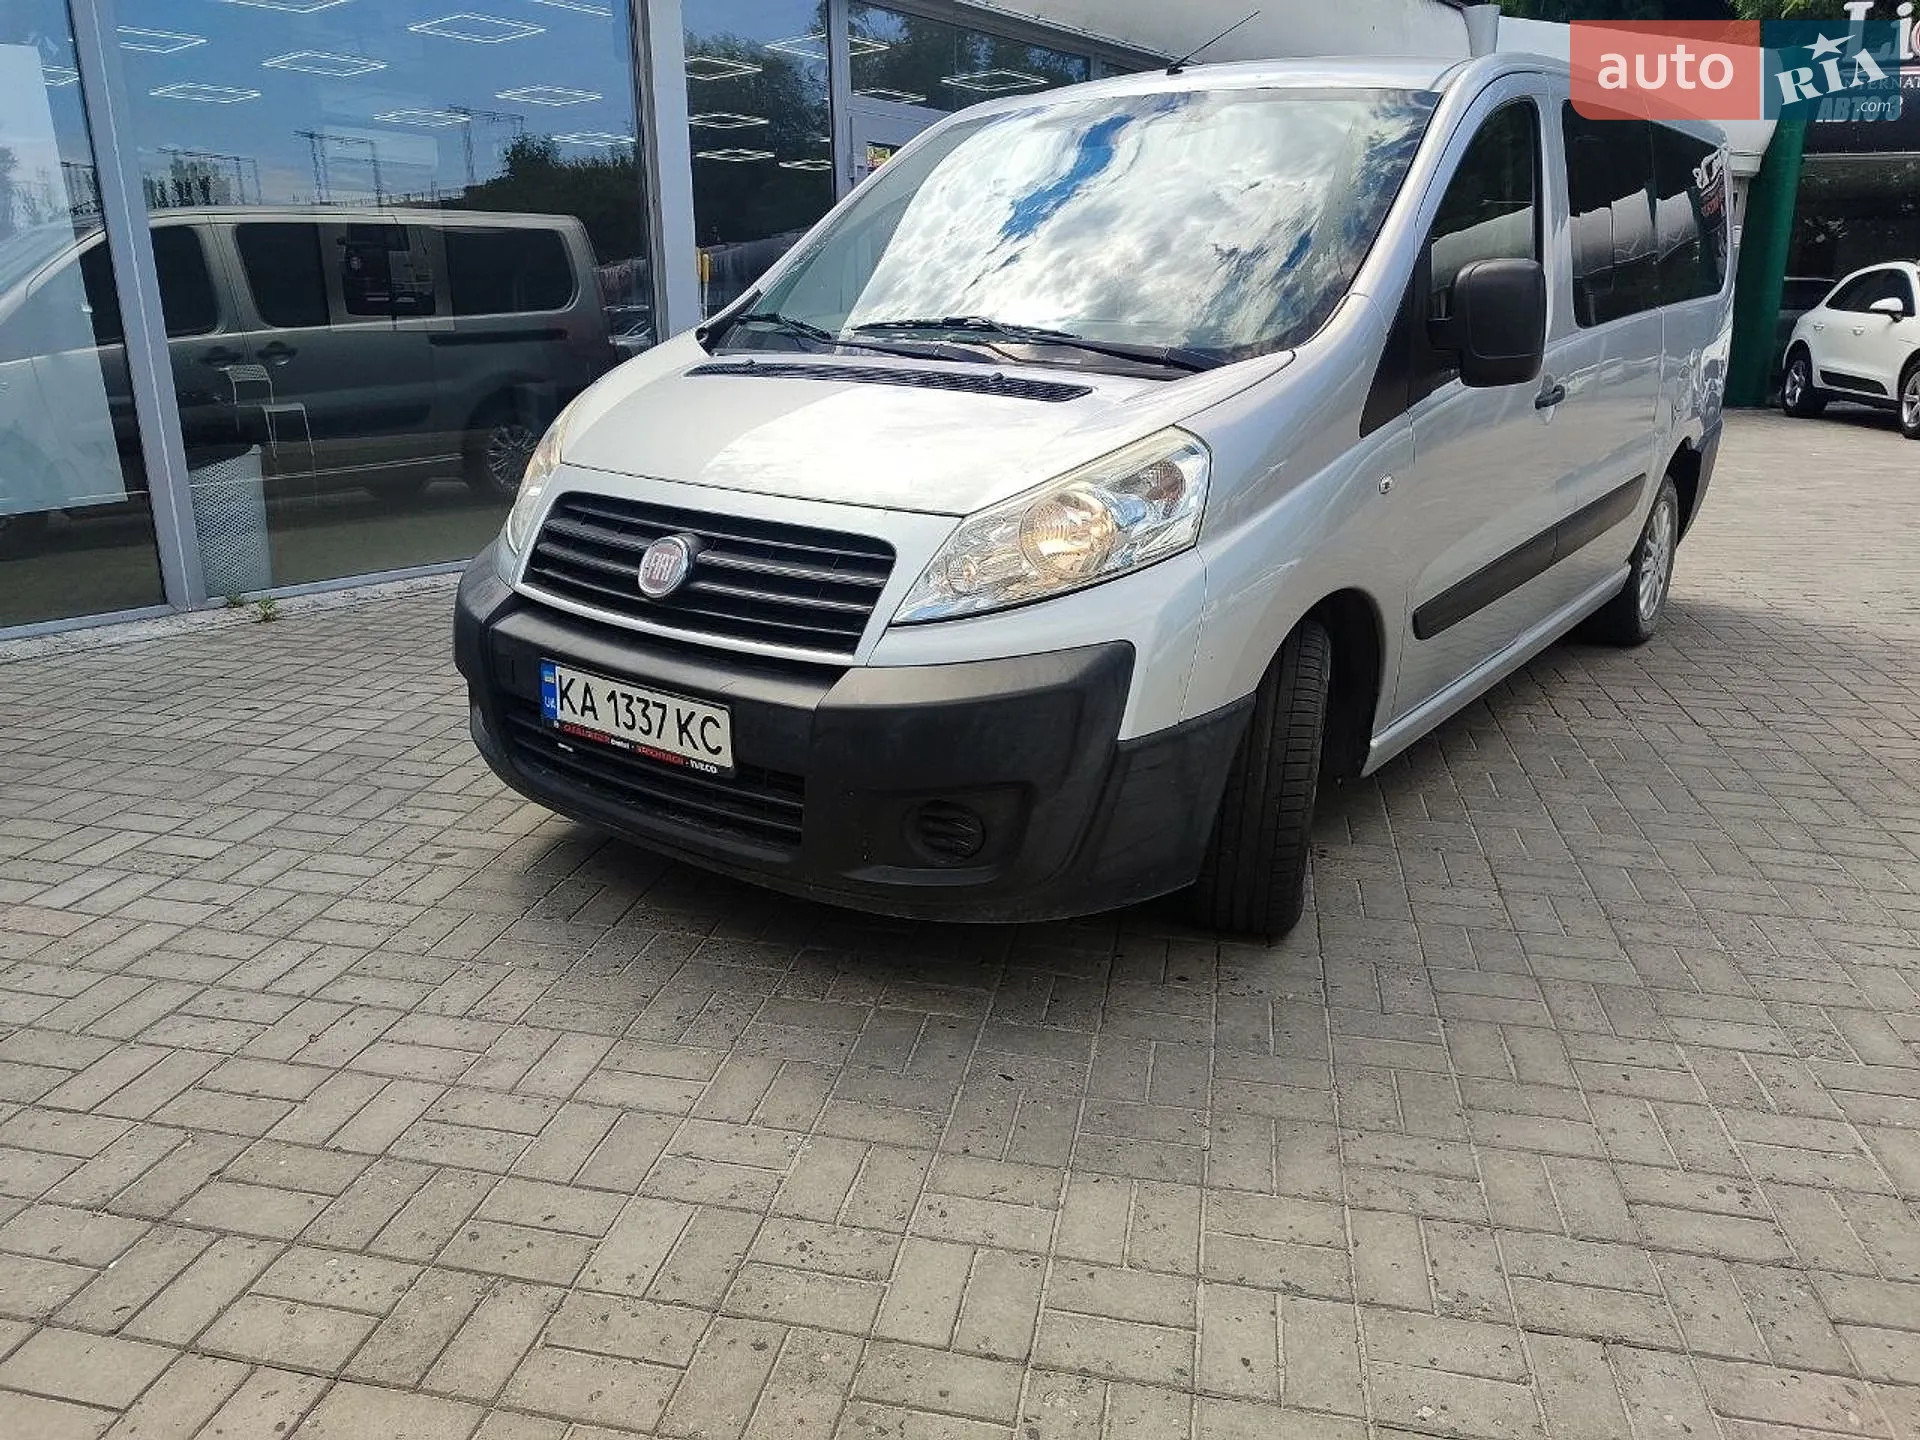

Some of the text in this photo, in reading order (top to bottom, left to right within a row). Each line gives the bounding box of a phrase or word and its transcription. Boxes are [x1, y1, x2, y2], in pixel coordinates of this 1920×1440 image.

[645, 551, 681, 580] FIAT
[558, 675, 599, 721] KA
[607, 690, 667, 739] 1337
[676, 708, 722, 755] KC
